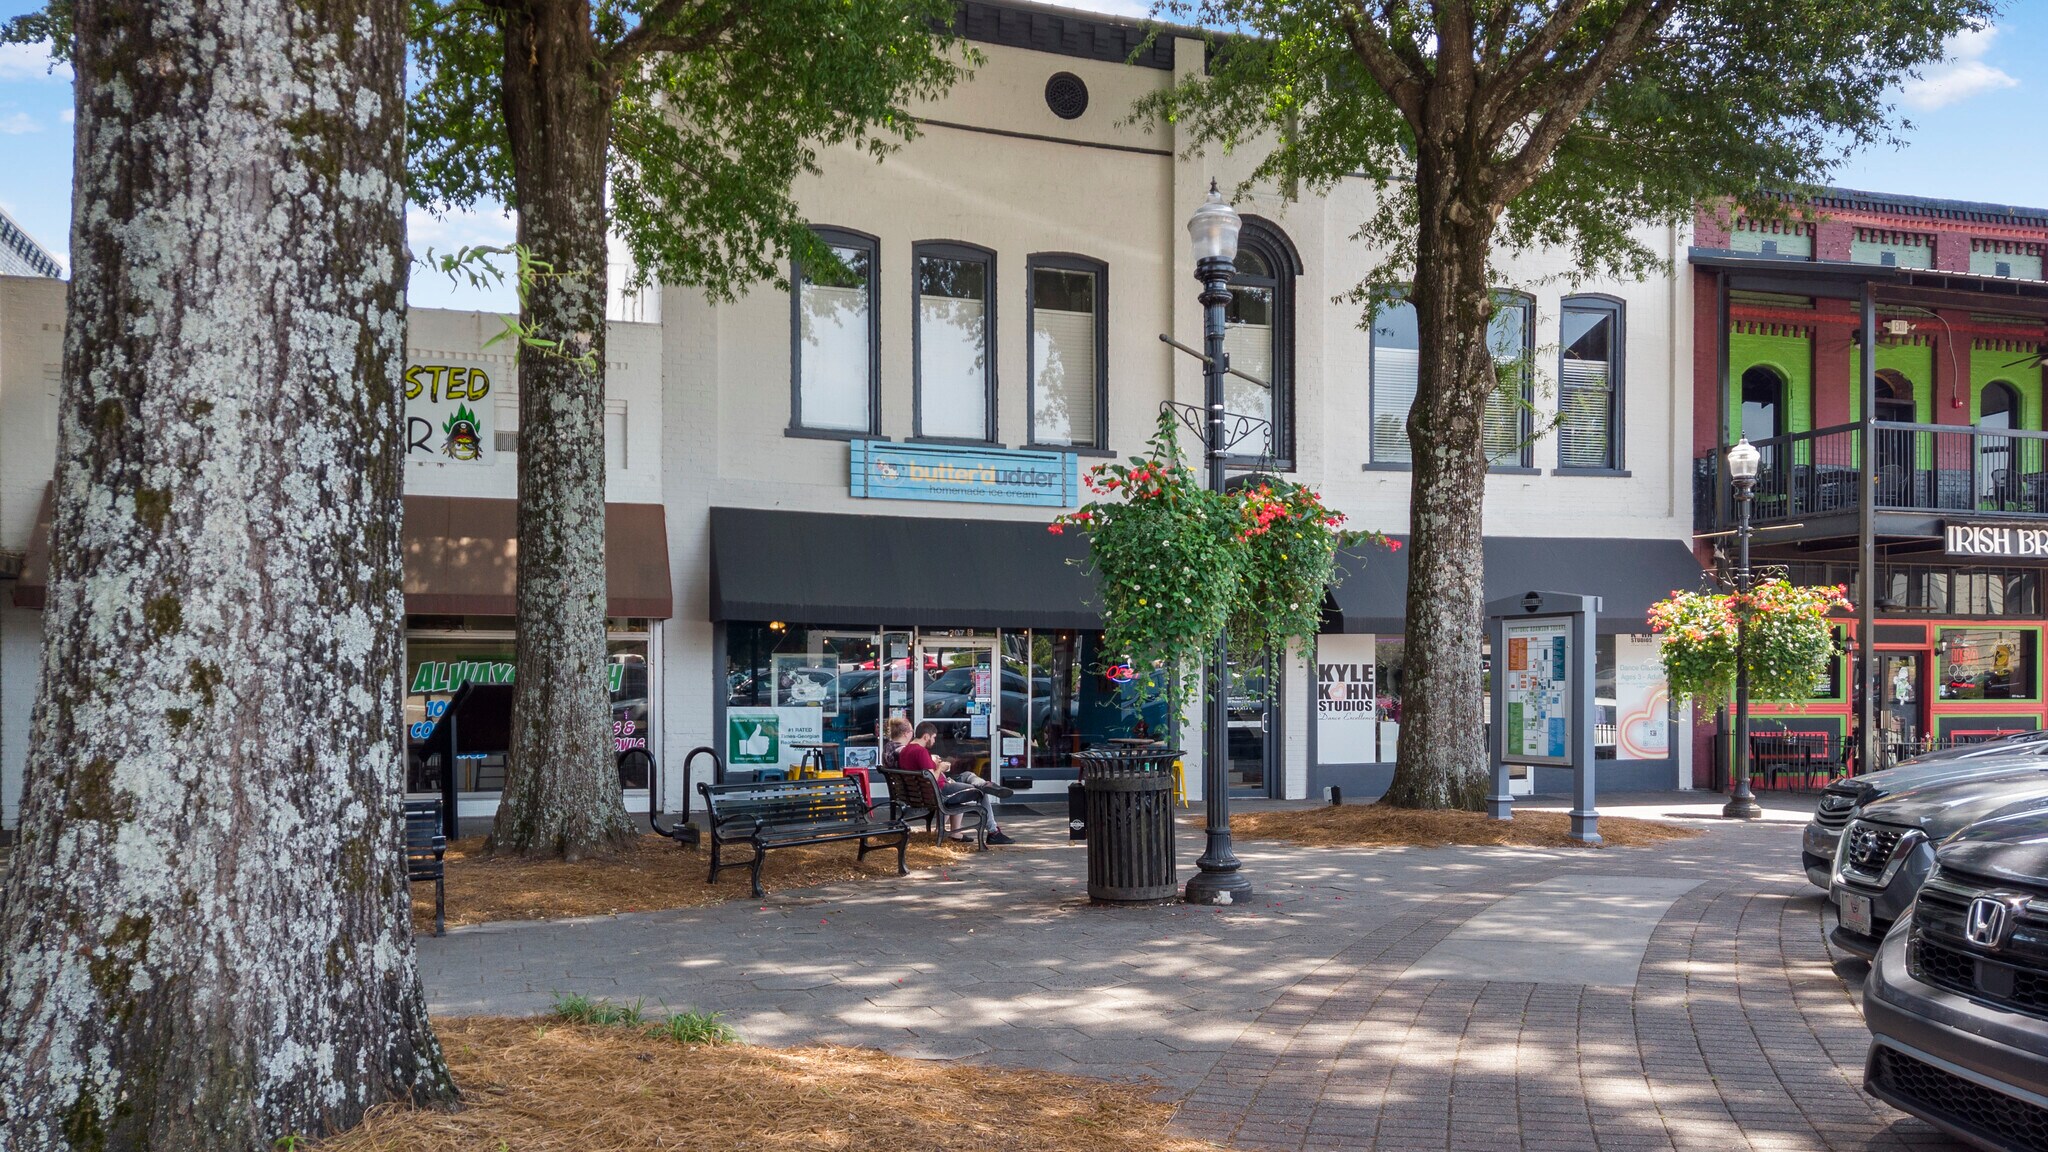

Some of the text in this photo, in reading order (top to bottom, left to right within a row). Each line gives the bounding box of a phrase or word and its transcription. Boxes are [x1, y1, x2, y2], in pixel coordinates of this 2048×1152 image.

[929, 484, 1038, 499] homemade ice cream
[1947, 525, 2011, 554] IRISH
[411, 661, 515, 692] ALWAY
[1318, 664, 1374, 682] KYLE
[1318, 700, 1373, 711] STUDIOS
[1318, 712, 1341, 720] Dance
